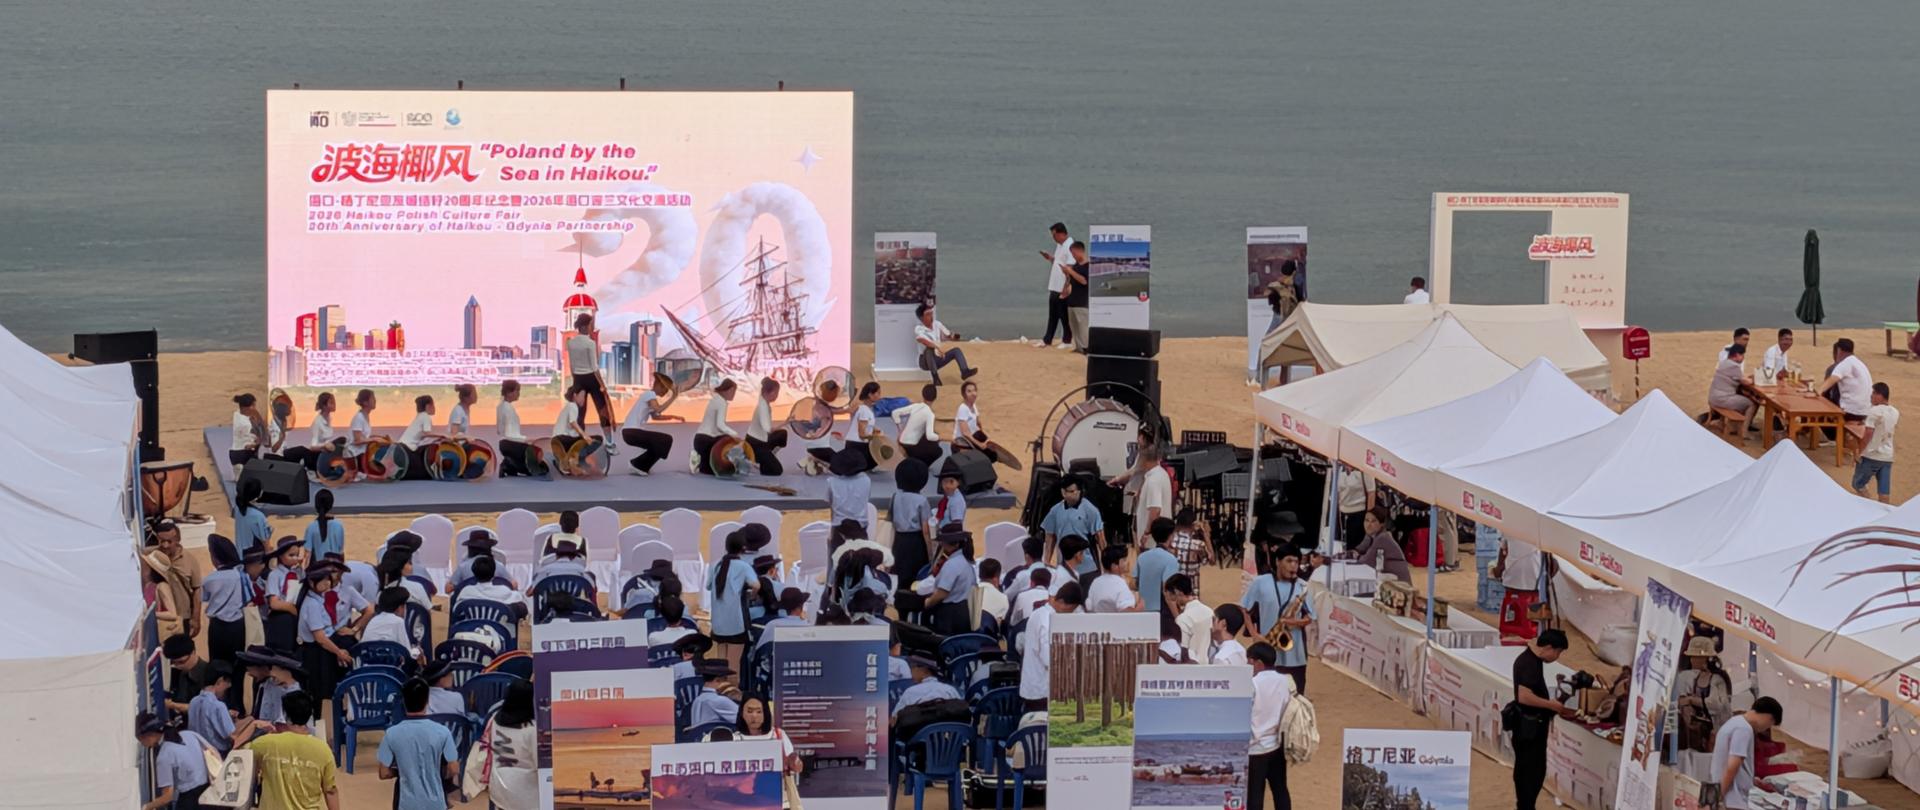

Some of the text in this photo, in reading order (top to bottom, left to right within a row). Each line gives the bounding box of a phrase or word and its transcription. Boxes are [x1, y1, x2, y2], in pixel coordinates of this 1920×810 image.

[570, 143, 596, 162] by
[602, 143, 636, 159] the
[311, 143, 479, 183] 波海椰风
[500, 166, 539, 181] Sea
[546, 165, 568, 181] in
[397, 210, 438, 220] Polish
[442, 210, 491, 220] Culture
[496, 210, 521, 220] Fair
[1346, 745, 1416, 764] 格丁尼亚
